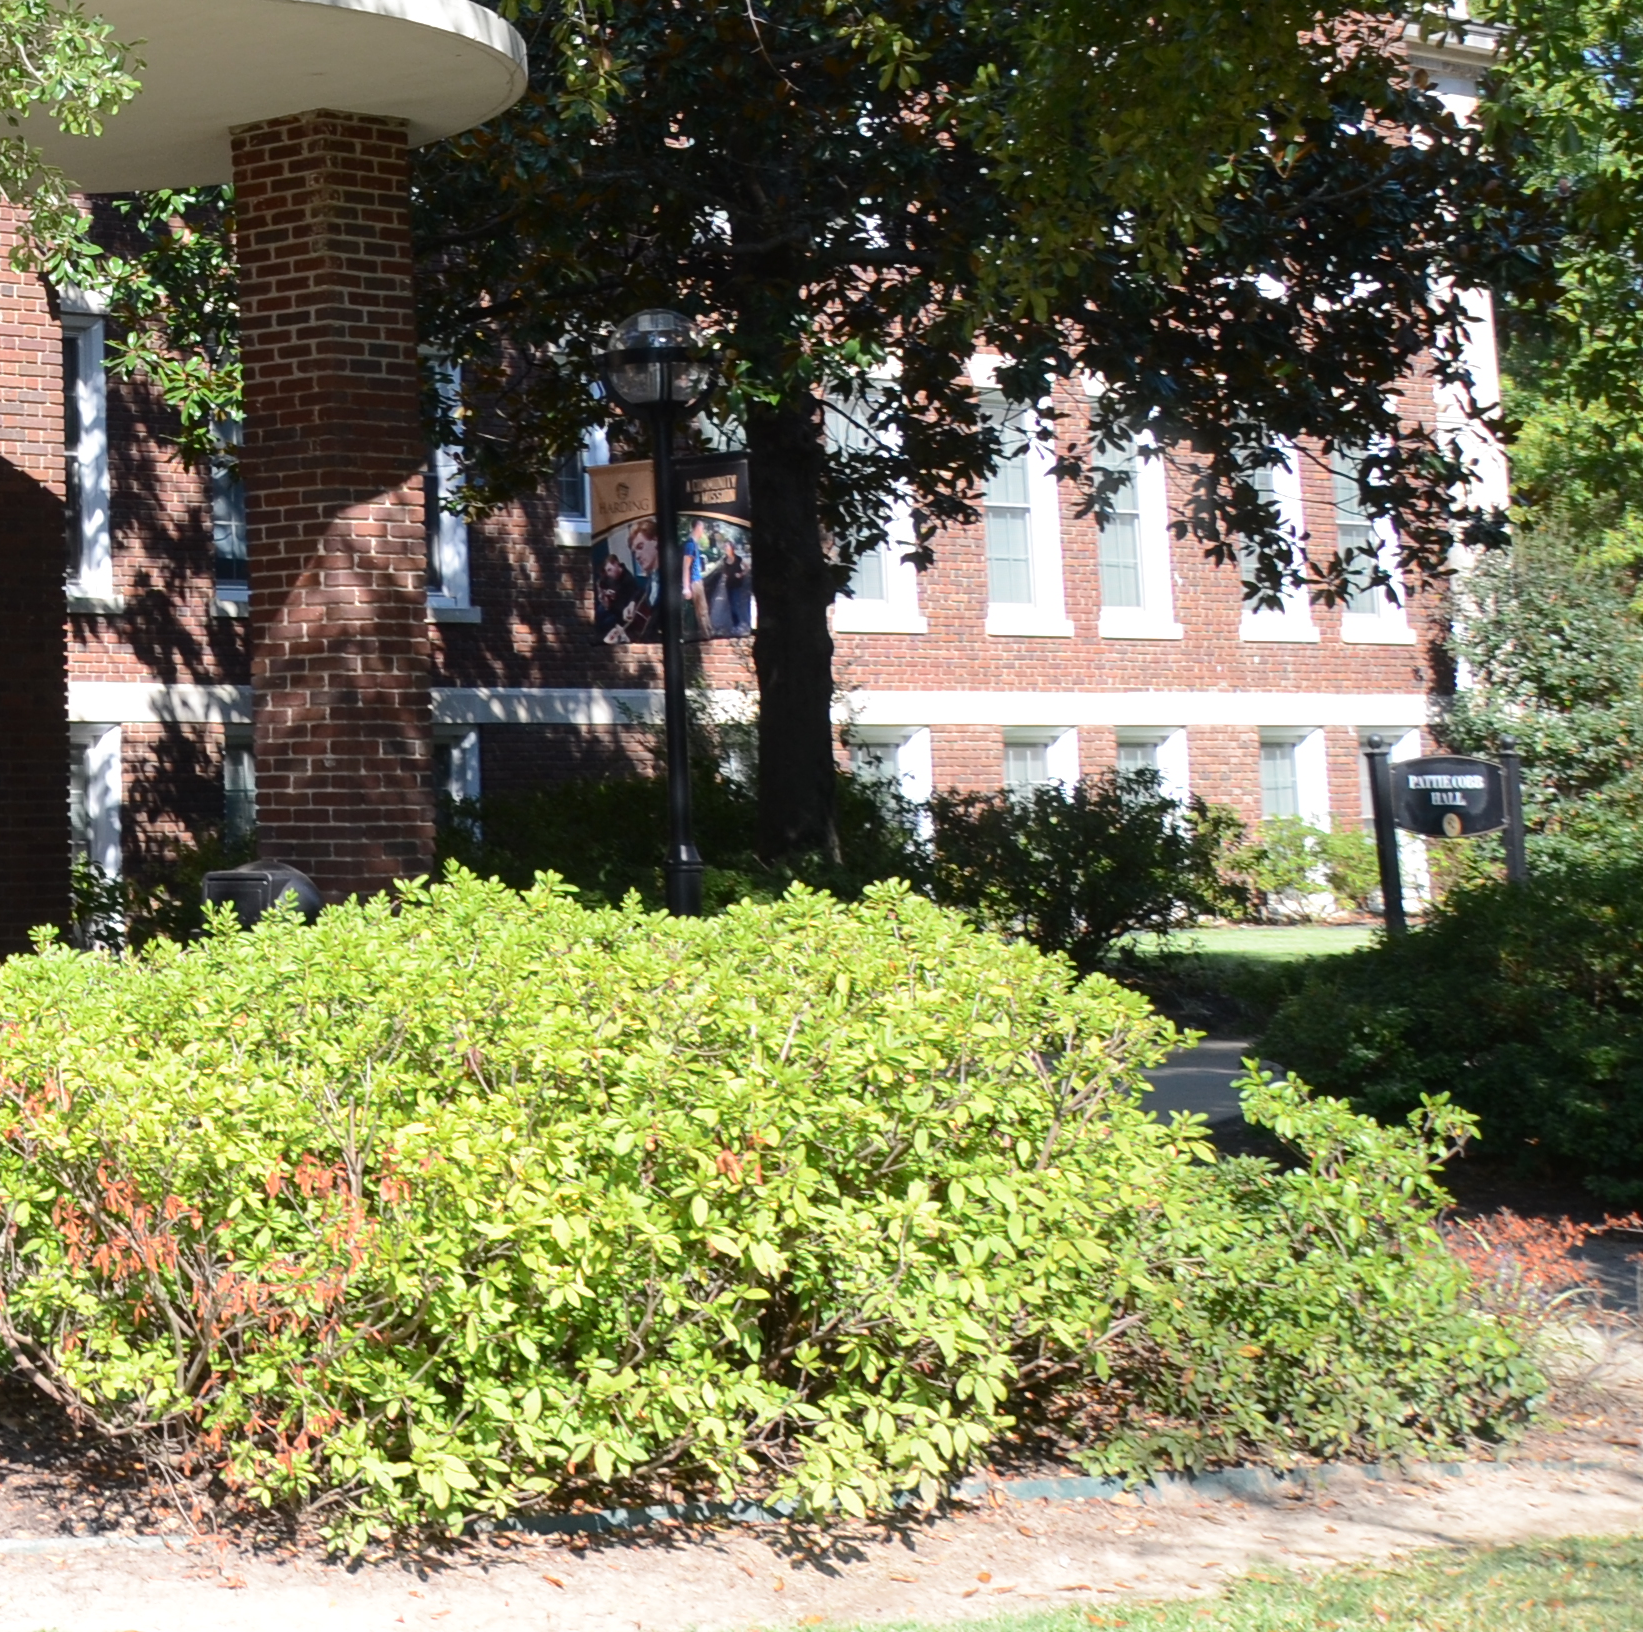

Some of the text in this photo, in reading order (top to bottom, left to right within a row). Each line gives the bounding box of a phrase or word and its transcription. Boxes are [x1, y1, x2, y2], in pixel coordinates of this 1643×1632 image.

[692, 474, 737, 491] COMMUNITY
[701, 488, 736, 504] MISSION
[598, 498, 650, 514] HARDING
[1408, 774, 1485, 789] PATTIE COBB
[1431, 792, 1467, 806] HALL
